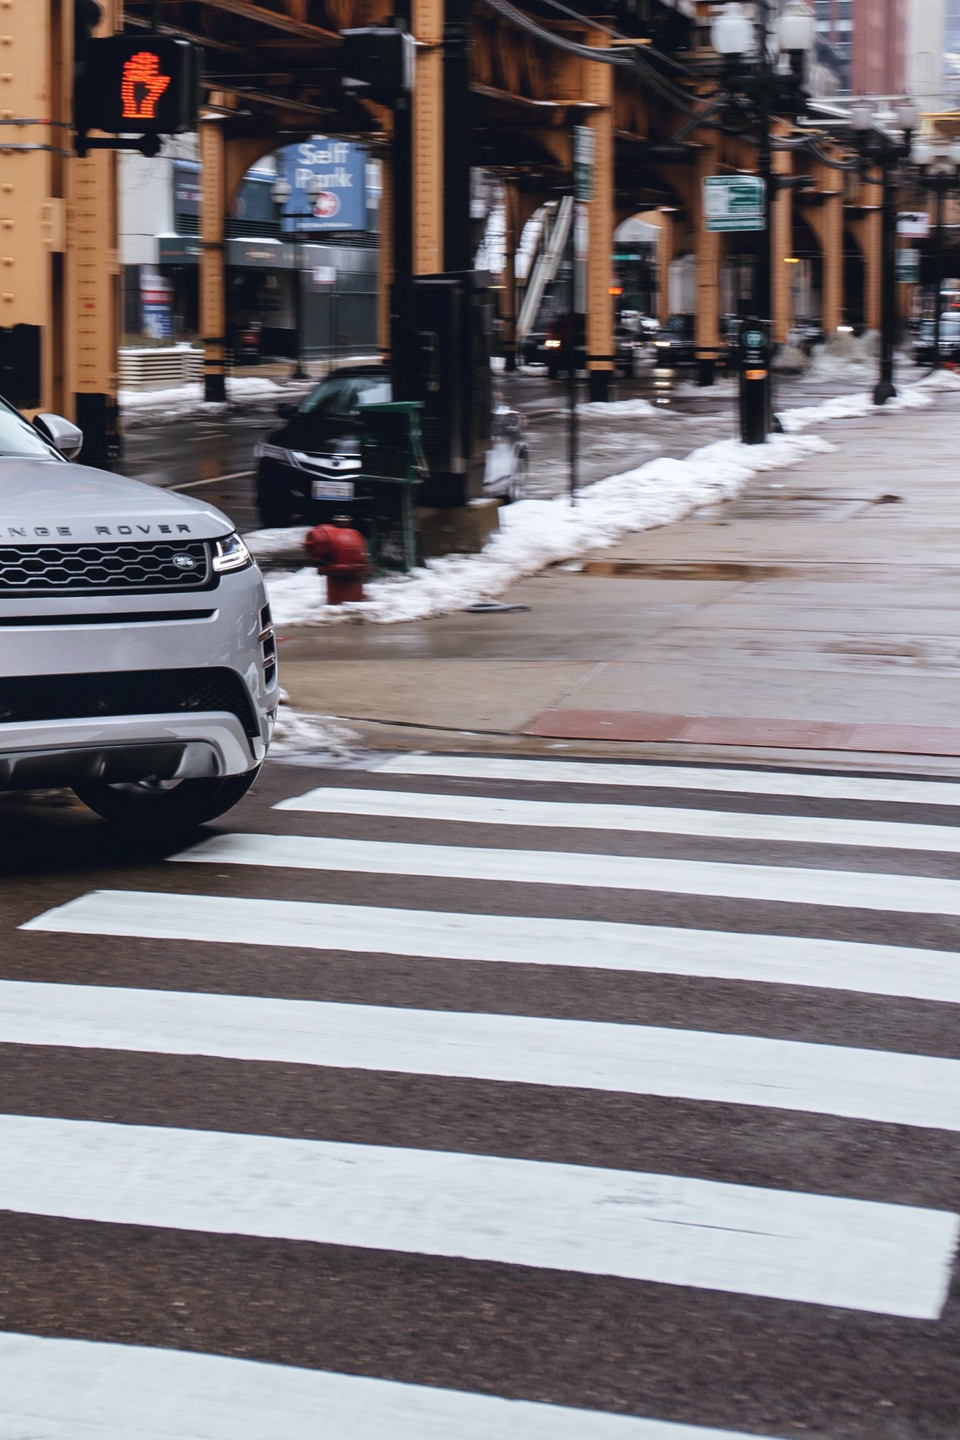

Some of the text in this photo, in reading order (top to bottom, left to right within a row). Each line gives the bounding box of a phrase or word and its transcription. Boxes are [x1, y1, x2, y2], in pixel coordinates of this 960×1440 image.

[297, 143, 349, 165] Self
[295, 167, 353, 189] Park
[94, 523, 191, 535] ROVER
